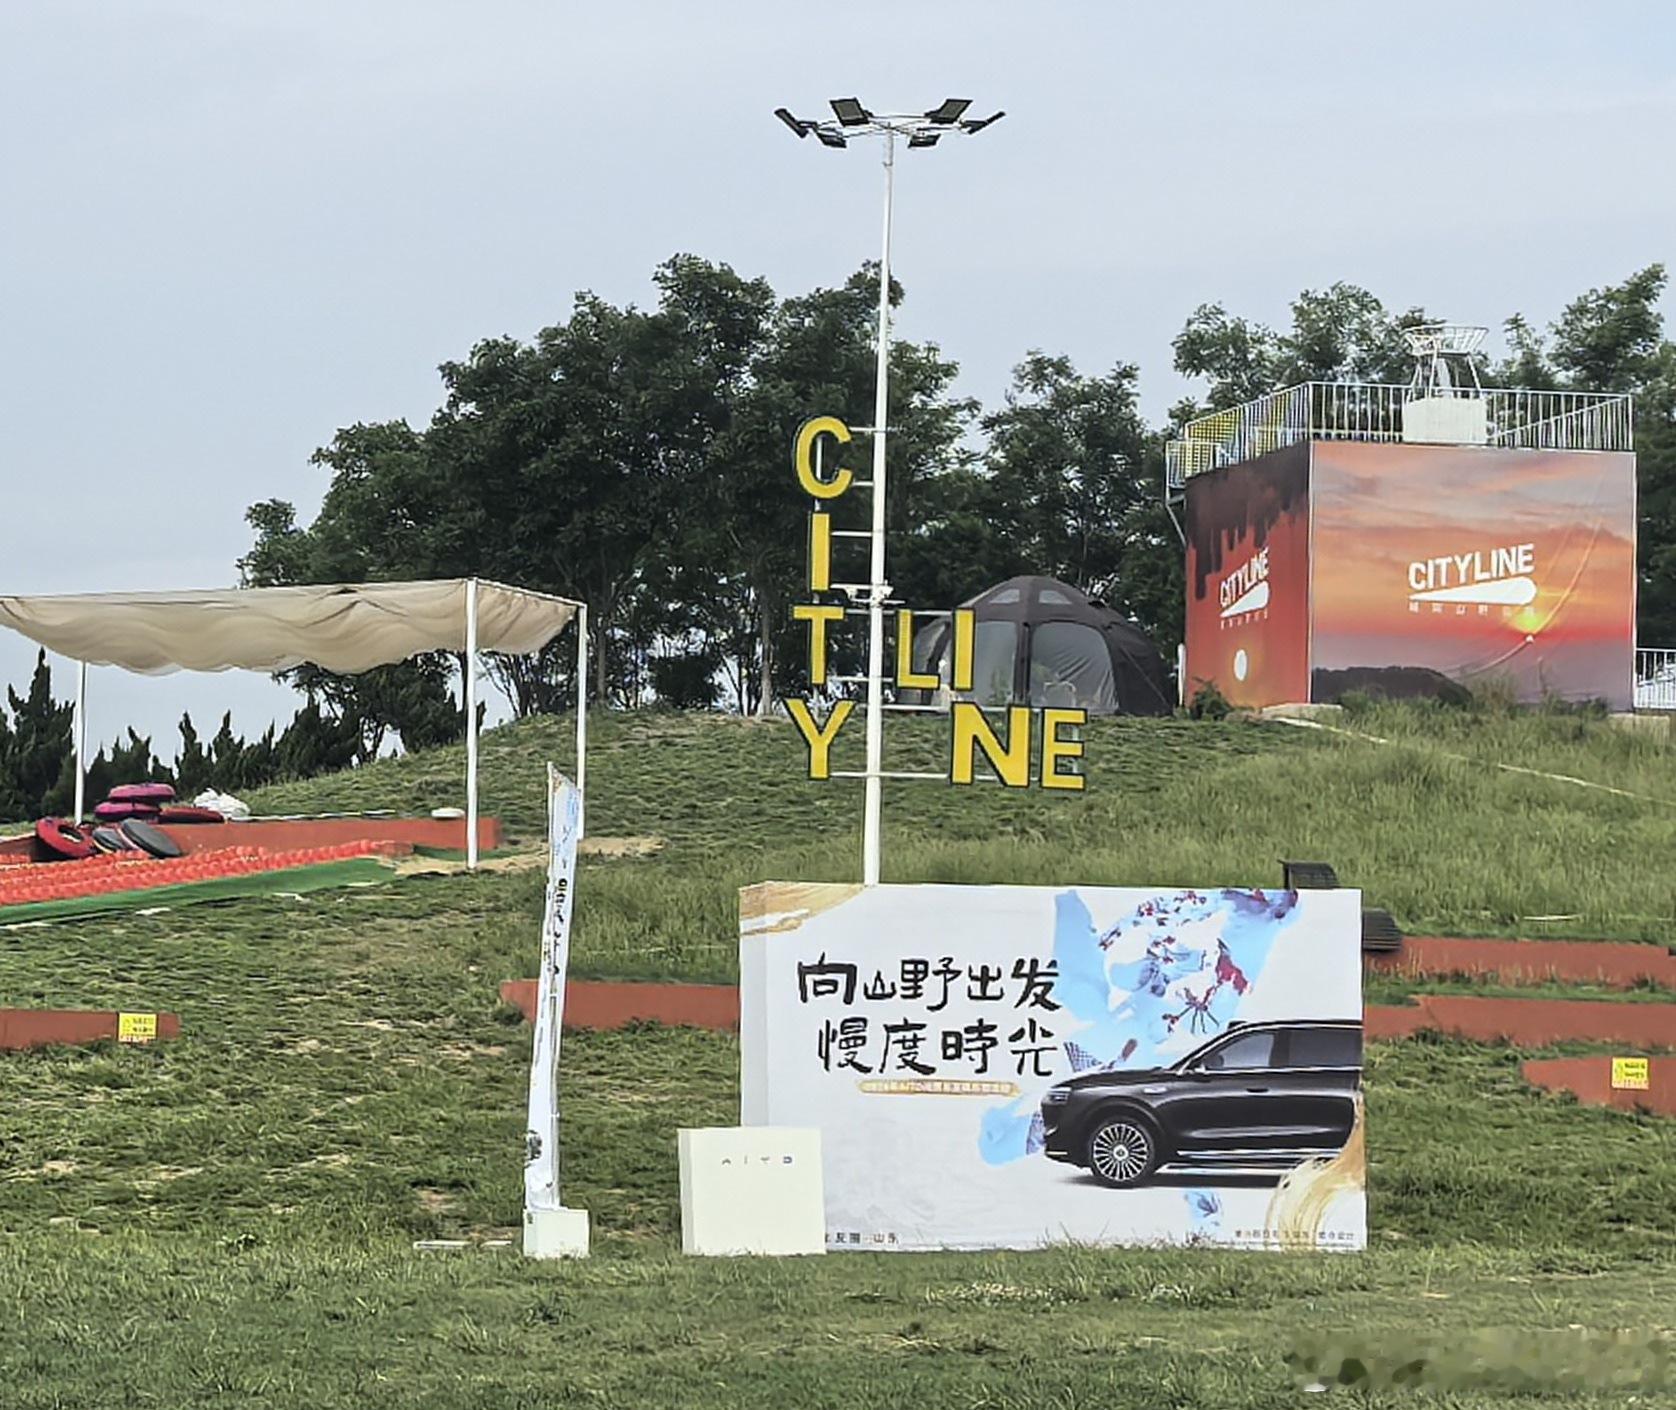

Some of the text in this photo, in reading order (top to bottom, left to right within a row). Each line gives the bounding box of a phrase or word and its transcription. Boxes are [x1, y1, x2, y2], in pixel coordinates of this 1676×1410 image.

[1220, 546, 1270, 608] CITYLINE
[1408, 543, 1535, 590] CITYLINE
[797, 952, 1061, 1012] 向山野出发
[817, 1017, 1058, 1077] 慢度時光
